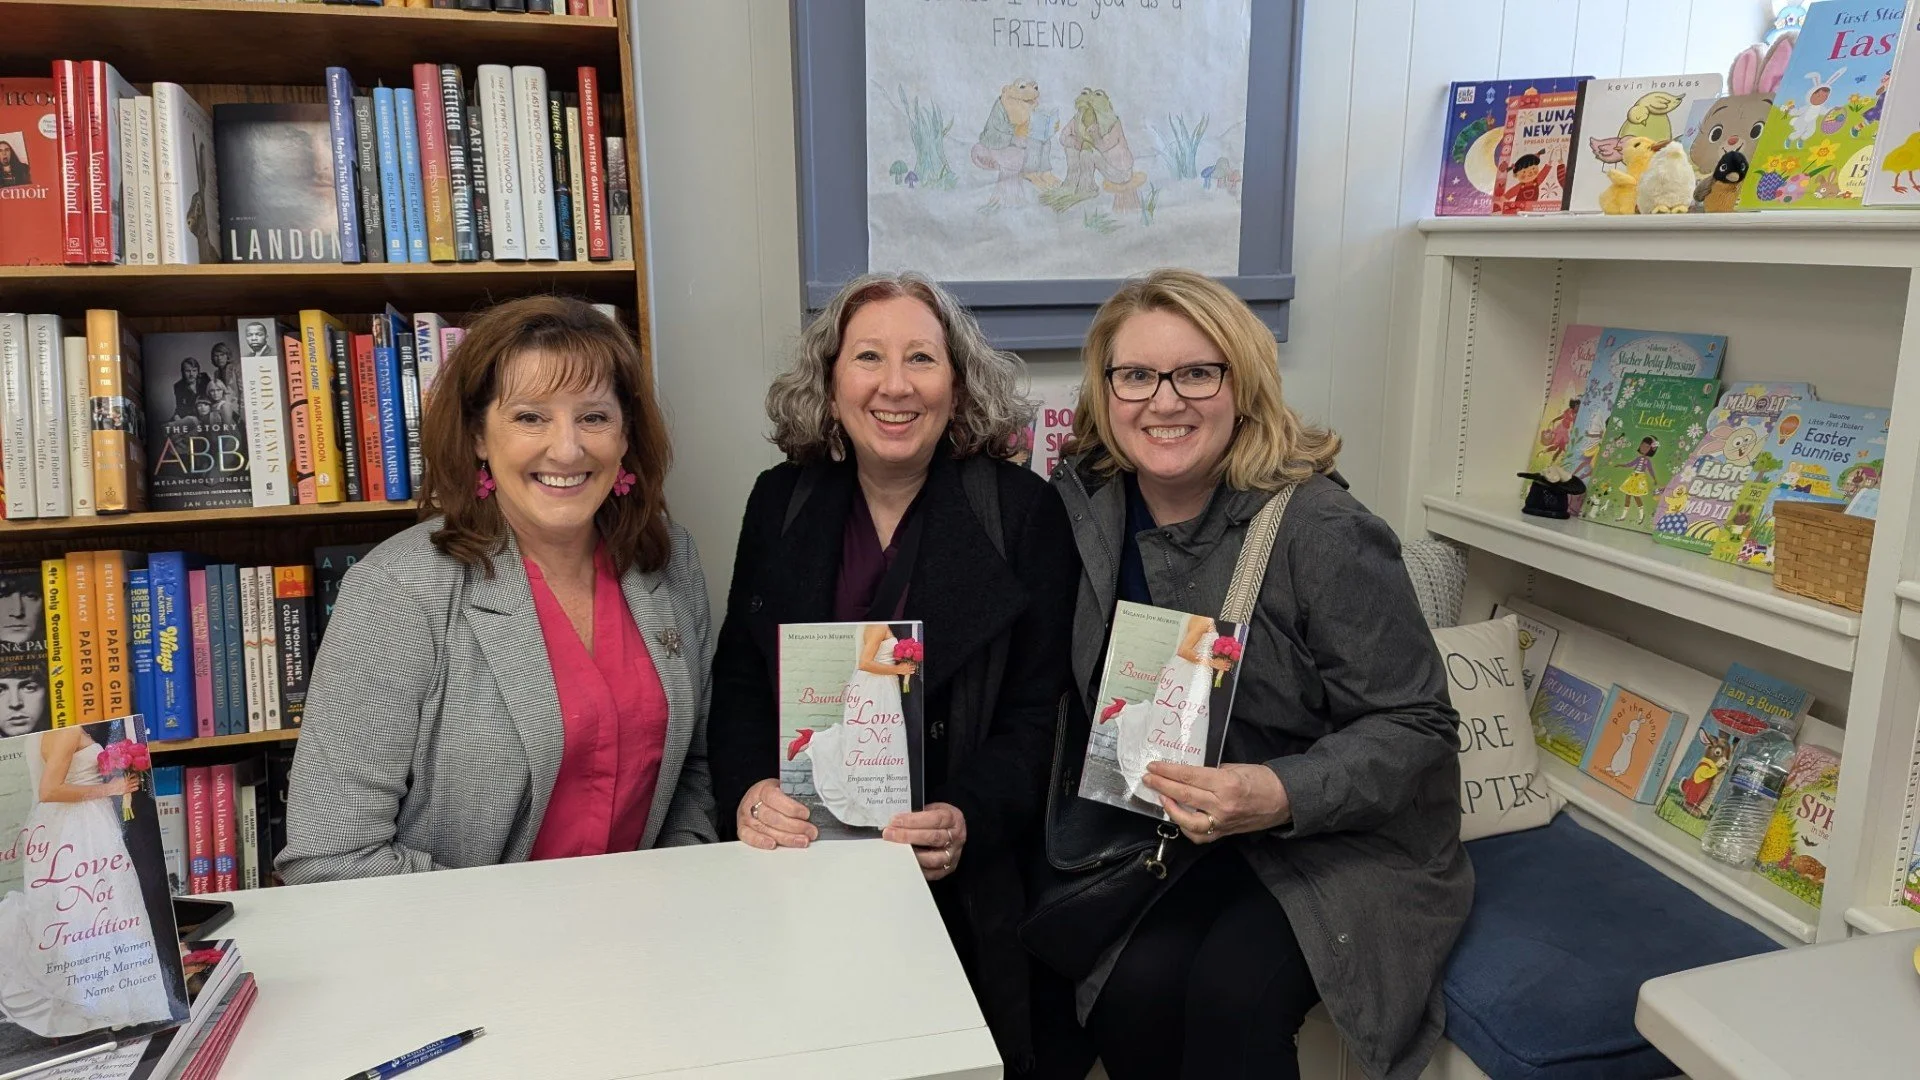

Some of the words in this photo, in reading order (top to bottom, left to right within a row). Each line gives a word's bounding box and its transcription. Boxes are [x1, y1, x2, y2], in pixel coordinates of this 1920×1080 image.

[1833, 10, 1869, 26] First
[993, 17, 1084, 49] FRIEND.
[1827, 30, 1897, 60] Eas
[331, 74, 339, 98] Tommy
[1608, 82, 1642, 91] kevin
[1652, 79, 1700, 89] henkes
[156, 90, 168, 134] RAISING
[442, 69, 461, 130] UNFETTERED
[584, 78, 594, 126] SUBMERSED
[333, 99, 342, 130] Dorfman
[357, 105, 371, 139] Griffin
[550, 100, 562, 131] FUTURE
[1537, 109, 1576, 123] LUNA
[470, 128, 482, 153] ART
[554, 132, 563, 150] BOY
[1523, 125, 1554, 138] NEW
[1524, 138, 1544, 146] SPREAD
[161, 139, 169, 166] HARE
[336, 137, 347, 164] Maybe
[362, 142, 373, 172] Dunne
[449, 144, 464, 170] JOHN
[588, 134, 597, 173] MATTHEW
[64, 151, 81, 213] Vagabond
[90, 151, 107, 213] Vagabond
[339, 165, 348, 183] This
[474, 158, 486, 194] THIEF
[0, 185, 49, 199] emoir
[340, 184, 349, 201] Will
[453, 173, 470, 232] FETTERMAN
[590, 176, 599, 202] GAVIN
[342, 202, 350, 221] Save
[592, 203, 601, 231] FRANK
[166, 222, 175, 258] DALTON
[344, 223, 351, 235] Me
[231, 229, 341, 260] LANDON
[288, 343, 300, 364] THE
[416, 320, 432, 362] AWAKE
[306, 326, 317, 362] LEAVING
[312, 365, 320, 390] HOME
[380, 350, 389, 366] 107
[1618, 351, 1640, 366] Sticker
[1643, 352, 1662, 372] Dolly
[1664, 355, 1696, 376] Dressing
[260, 365, 274, 410] JOHN
[291, 371, 304, 398] TELL
[380, 368, 391, 394] DAYS
[314, 396, 322, 422] MARK
[1725, 394, 1757, 410] MAD
[165, 426, 188, 434] THE
[197, 424, 237, 432] STORY
[296, 411, 304, 428] AMY
[342, 400, 353, 438] GABRIELLE
[382, 398, 396, 443] KAMALA
[1638, 410, 1676, 427] Easter
[1826, 420, 1838, 428] First
[1840, 422, 1864, 431] Stickers
[16, 418, 26, 454] Virginia
[48, 418, 58, 454] Virginia
[252, 410, 262, 460] GREENBERG
[264, 419, 280, 473] LEWIS
[316, 424, 326, 462] HADDON
[408, 427, 420, 443] JOY
[1804, 428, 1856, 448] Easter
[154, 435, 250, 475] ABB
[298, 434, 308, 470] GRIFFIN
[344, 442, 356, 478] HAMILTON
[386, 446, 399, 484] HARRIS
[410, 446, 422, 475] HARJO
[1792, 442, 1851, 464] Bunnies
[18, 456, 26, 489] Roberts
[52, 456, 60, 489] Roberts
[1699, 461, 1752, 481] EASTE
[1689, 480, 1742, 500] BASKE
[1684, 501, 1712, 516] MAD
[1710, 504, 1732, 520] LI
[48, 567, 58, 584] It's
[76, 564, 85, 588] BETH
[104, 564, 114, 588] BETH
[49, 588, 60, 610] Only
[78, 594, 87, 622] MACY
[106, 594, 115, 620] MACY
[132, 614, 150, 623] NO
[52, 614, 62, 662] Drowning
[134, 629, 151, 640] OF
[80, 631, 92, 674] PAPER
[106, 629, 120, 673] PAPER
[156, 626, 178, 672] Wings
[228, 642, 238, 657] VAL
[286, 653, 294, 686] SILENCE
[294, 660, 302, 680] THEY
[1120, 661, 1162, 682] Bound
[1160, 667, 1175, 690] by
[1446, 652, 1514, 690] ONE
[110, 680, 122, 713] GIRL
[230, 660, 240, 707] McDERMID
[799, 687, 847, 704] Bound
[846, 684, 861, 708] by
[82, 682, 94, 715] GIRL
[1156, 686, 1208, 718] Love,
[1555, 700, 1592, 724] BUNNY
[1722, 682, 1729, 694] I
[1728, 688, 1746, 702] am
[1746, 696, 1754, 706] a
[1757, 696, 1794, 719] Bunny
[846, 700, 904, 727] Love,
[1612, 709, 1626, 725] pat
[1630, 704, 1643, 712] the
[1646, 710, 1656, 745] bunny
[858, 727, 892, 744] Not
[1147, 729, 1202, 755] Tradition
[1459, 714, 1514, 754] ORE
[846, 747, 904, 766] Tradition
[214, 773, 225, 796] Softly,
[847, 774, 884, 783] Empowering
[886, 774, 908, 782] Women
[857, 786, 882, 794] Through
[216, 799, 226, 808] As
[1460, 772, 1549, 815] PTER.
[218, 815, 227, 836] Leave
[1810, 826, 1818, 834] in
[1818, 829, 1830, 840] the
[26, 825, 50, 862] by
[218, 838, 228, 852] You
[30, 844, 130, 889] Love,
[56, 878, 114, 911] Not
[38, 907, 140, 950] Tradition
[46, 951, 110, 974] Empowering
[114, 940, 152, 956] Women
[65, 967, 109, 986] Through
[112, 954, 154, 974] Married
[84, 985, 115, 1000] Name
[118, 974, 157, 990] Choices
